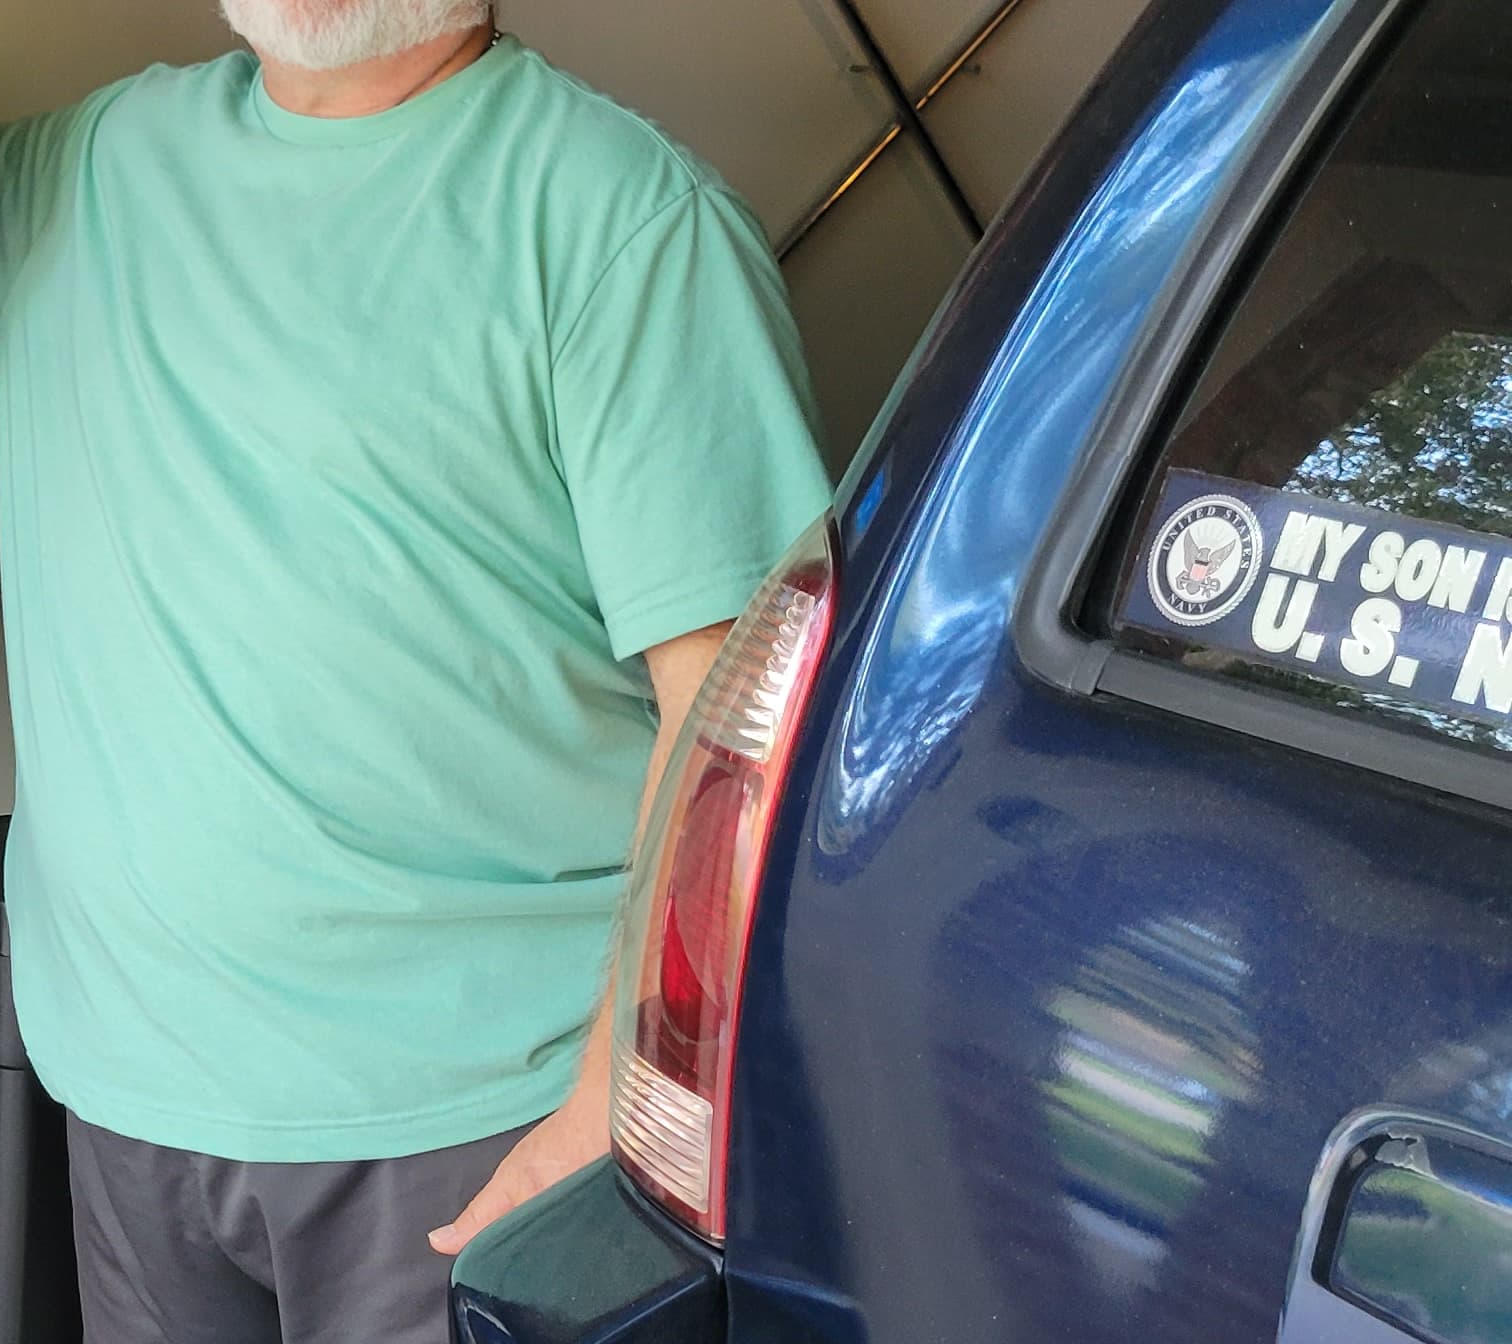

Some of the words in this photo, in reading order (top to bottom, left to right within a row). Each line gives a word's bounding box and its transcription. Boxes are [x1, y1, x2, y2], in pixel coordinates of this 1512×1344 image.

[1162, 506, 1216, 551] UNITED
[1223, 509, 1253, 569] STATES
[1270, 511, 1367, 582] MY
[1359, 531, 1487, 614] SON
[1482, 556, 1512, 625] I
[1168, 592, 1208, 614] NAVY
[1251, 572, 1325, 663] U.
[1340, 597, 1419, 689] S.
